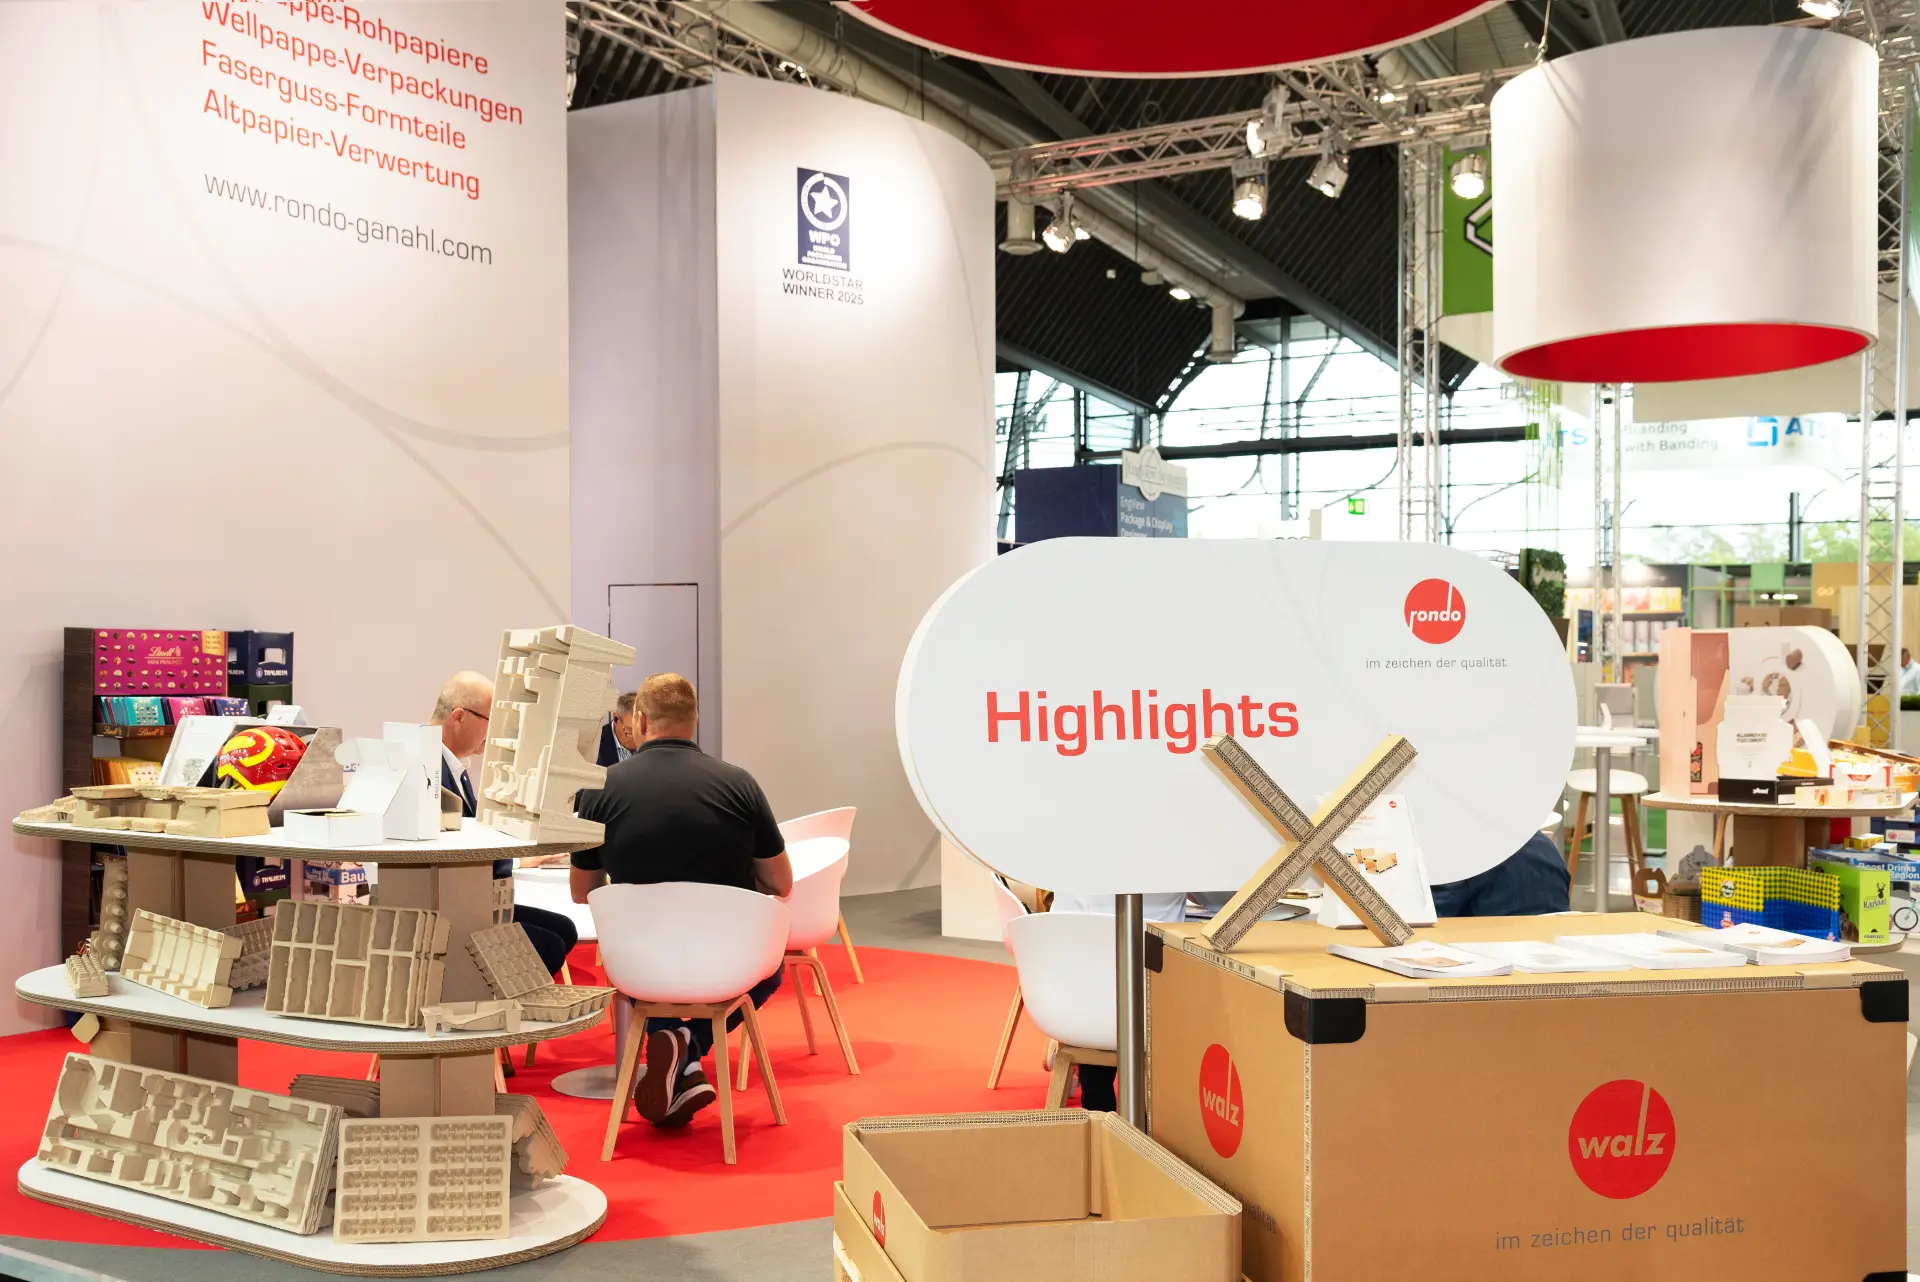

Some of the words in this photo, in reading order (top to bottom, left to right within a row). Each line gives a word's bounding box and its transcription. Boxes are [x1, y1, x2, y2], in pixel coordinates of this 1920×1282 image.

[276, 0, 489, 75] ppe-Rohpapiere
[202, 2, 523, 125] Wellpappe-Verpackungen
[202, 39, 466, 149] Faserguss-Formteile
[203, 89, 480, 200] Altpapier-Verwertung
[204, 173, 492, 265] www.rondo-ganahl.com
[809, 230, 841, 247] WPO
[782, 267, 864, 291] WORLDSTAR
[782, 282, 834, 300] WINNER
[837, 290, 864, 306] 2025
[1659, 437, 1719, 452] Banding
[1409, 580, 1463, 633] rondo
[148, 645, 176, 657] Lindt
[1366, 658, 1381, 668] im
[1385, 657, 1432, 668] zeichen
[1436, 657, 1457, 668] der
[1460, 656, 1507, 671] qualität
[986, 688, 1299, 757] Highlights
[341, 870, 366, 883] Bau
[1887, 864, 1916, 872] Drinks
[1578, 1083, 1666, 1159] walz
[1496, 1232, 1520, 1251] im
[1531, 1226, 1611, 1248] zeichen
[1622, 1222, 1656, 1242] der
[1666, 1216, 1745, 1241] qualität
